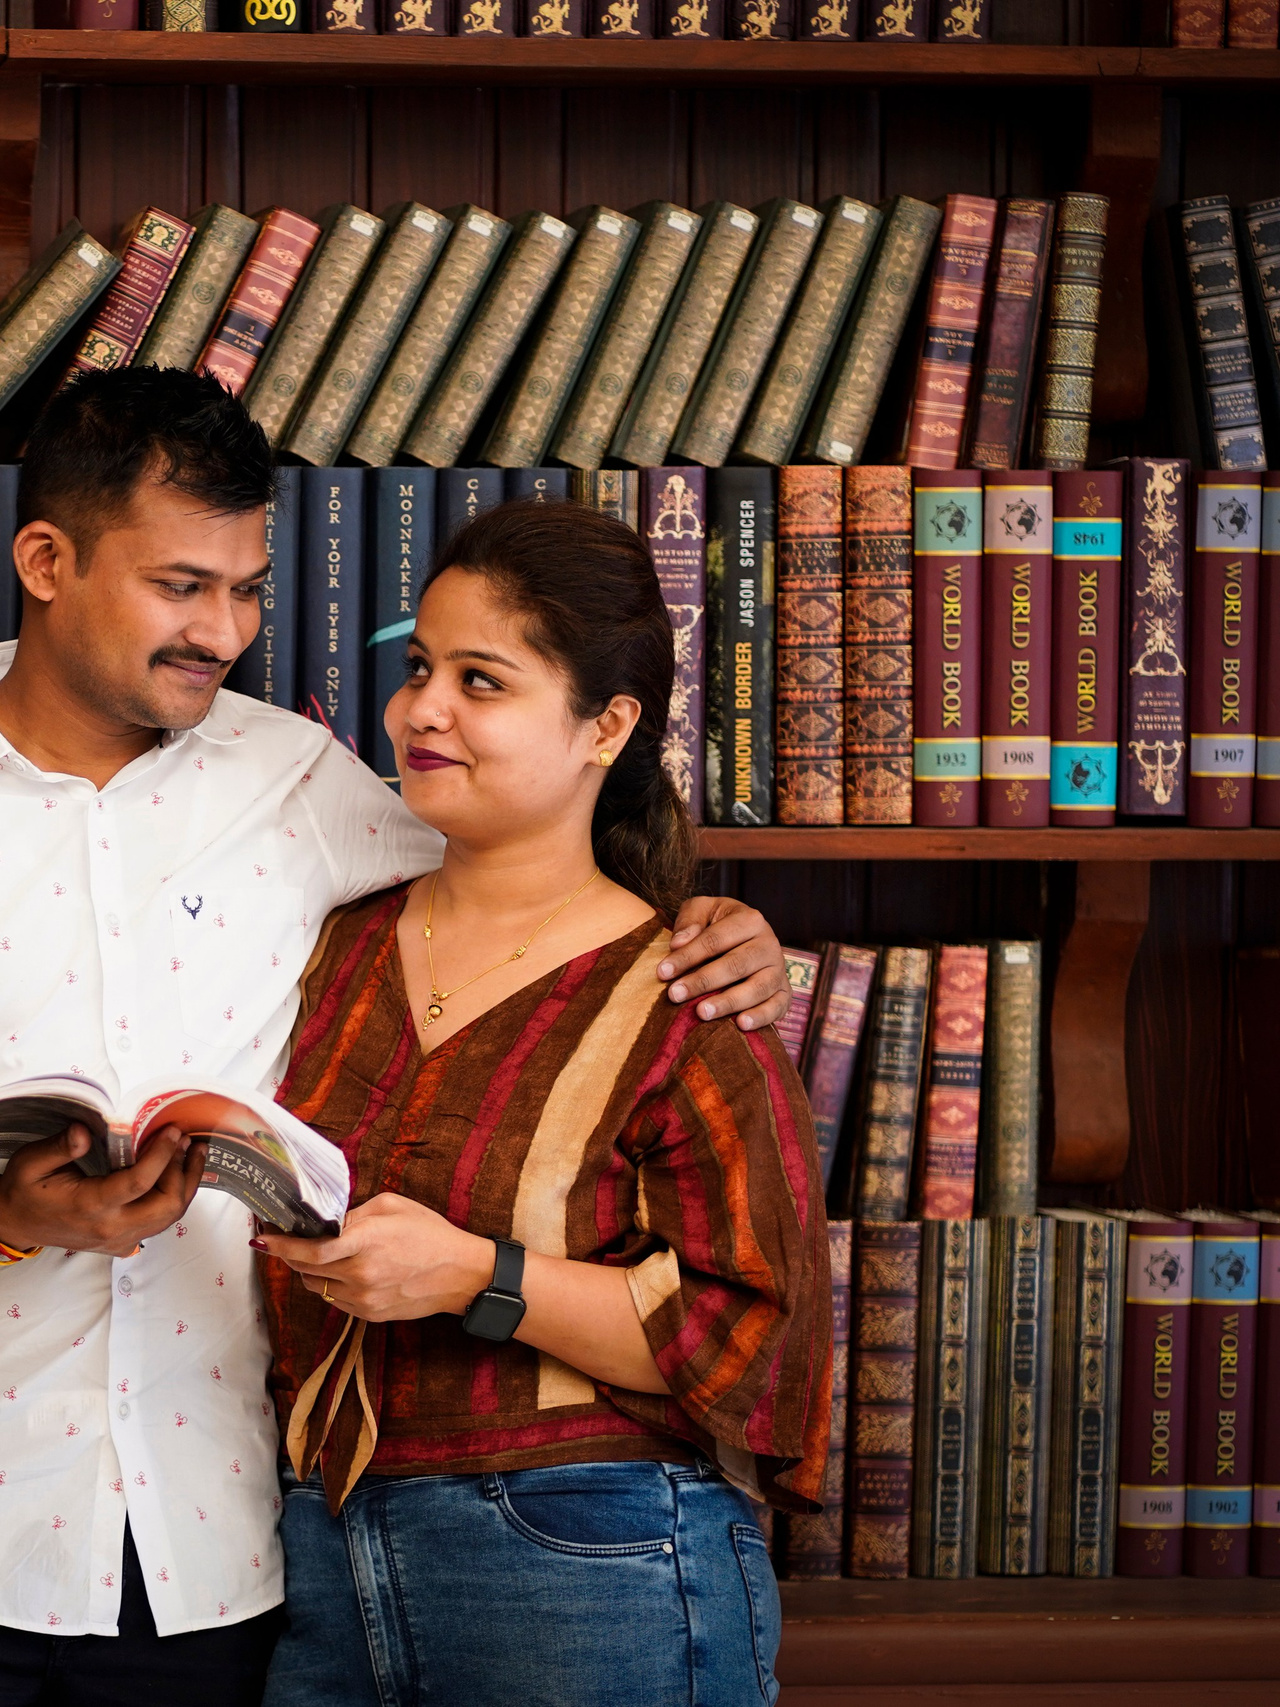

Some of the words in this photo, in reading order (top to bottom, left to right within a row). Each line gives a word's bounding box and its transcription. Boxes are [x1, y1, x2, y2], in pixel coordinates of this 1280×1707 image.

[943, 255, 984, 267] NOVELS
[328, 486, 342, 524] FOR
[739, 500, 755, 568] SPENCER
[1073, 532, 1105, 545] 1948
[327, 538, 341, 589] YOUR
[398, 484, 415, 612] MOONRAKER
[653, 549, 701, 557] HISTORIC
[655, 558, 699, 566] MEMOIRS
[327, 602, 340, 653] EYES
[739, 578, 755, 628] JASON
[942, 563, 962, 650] WORLD
[1012, 562, 1031, 649] WORLD
[1078, 570, 1098, 637] BOOK
[1223, 561, 1243, 647] WORLD
[264, 625, 274, 704] CITIES
[326, 666, 340, 717] ONLY
[736, 642, 751, 709] BORDER
[942, 661, 962, 729] BOOK
[1010, 659, 1030, 727] BOOK
[1077, 647, 1098, 734] WORLD
[1222, 657, 1241, 725] BOOK
[735, 718, 752, 802] UNKNOWN
[934, 752, 966, 767] 1932
[1003, 751, 1034, 765] 1908
[1134, 723, 1182, 731] HISTORIC
[1214, 748, 1244, 763] 1907
[208, 1147, 275, 1191] PPLIED
[1153, 1312, 1174, 1399] WORLD
[1219, 1312, 1239, 1399] WORLD
[1151, 1409, 1171, 1476] BOOK
[1216, 1409, 1237, 1476] BOOK
[1142, 1500, 1173, 1514] 1908
[1208, 1500, 1238, 1515] 1902
